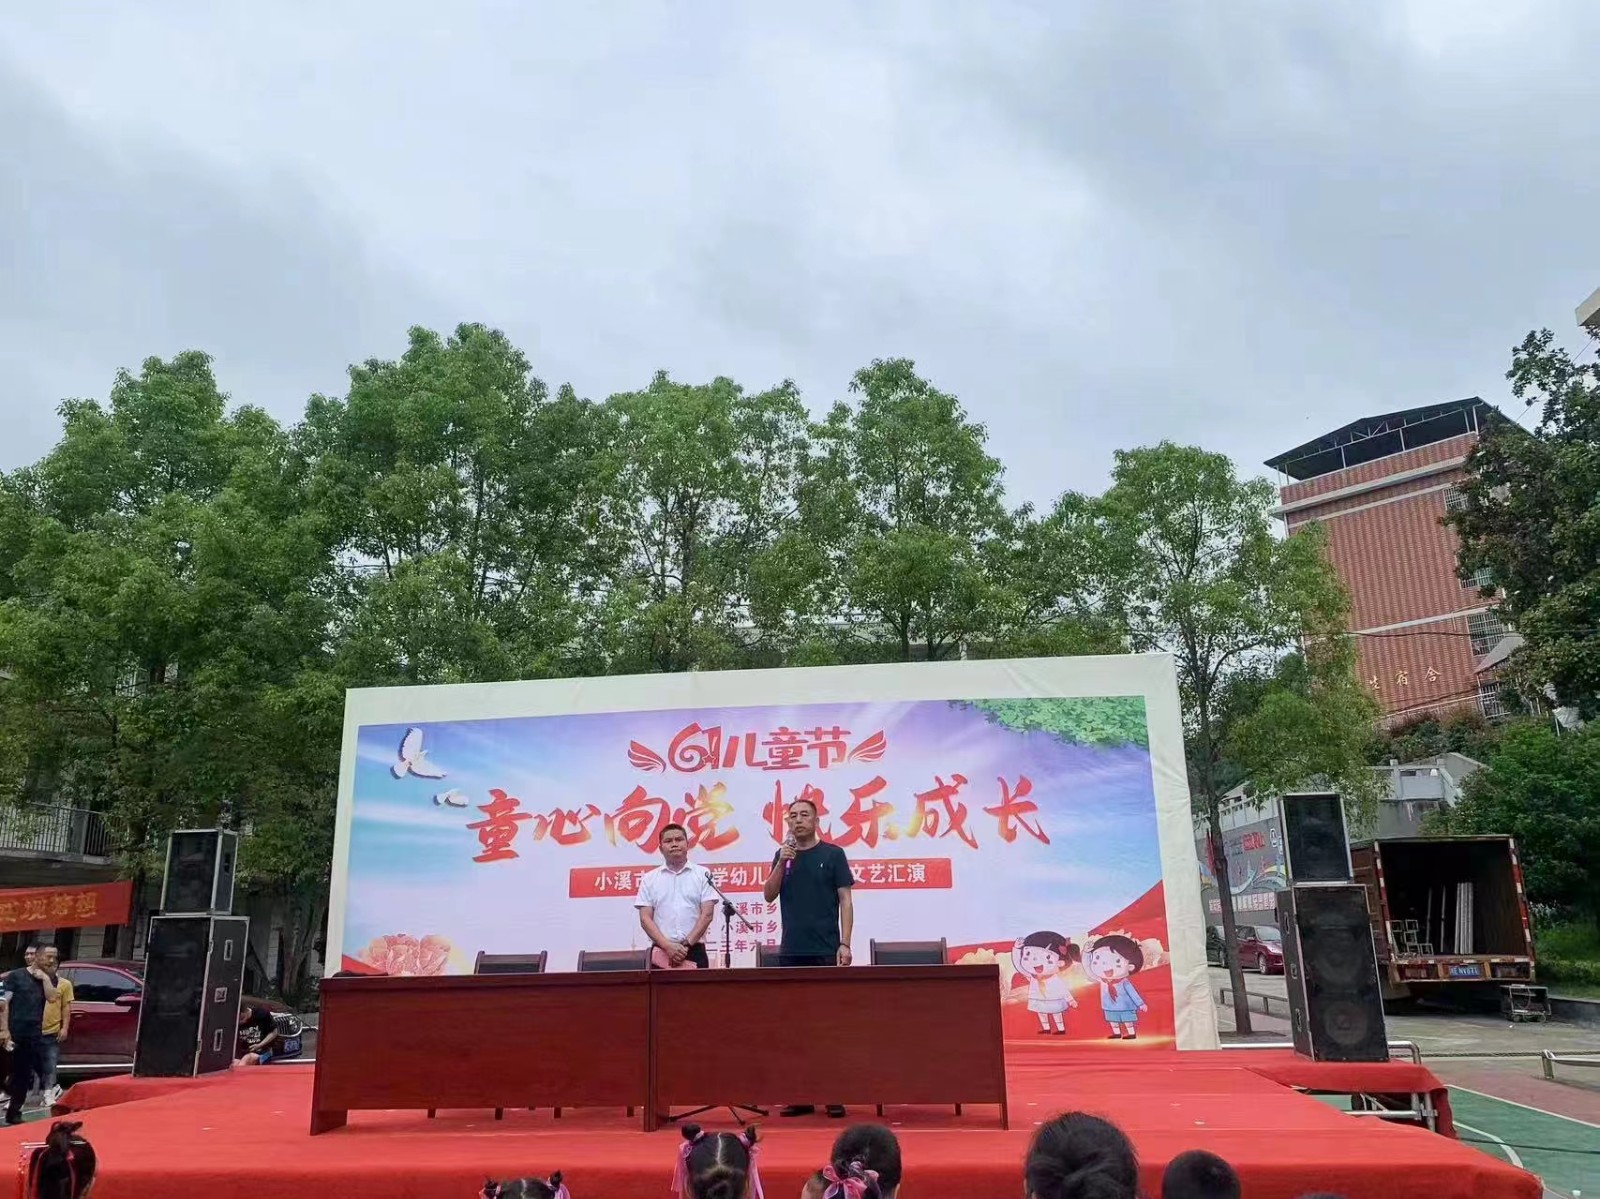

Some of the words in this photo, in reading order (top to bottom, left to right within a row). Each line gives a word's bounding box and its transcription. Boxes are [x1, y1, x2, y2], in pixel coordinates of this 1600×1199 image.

[466, 781, 740, 863] 童心向党
[763, 773, 1050, 850] 快乐成长
[723, 902, 778, 916] 溪市乡
